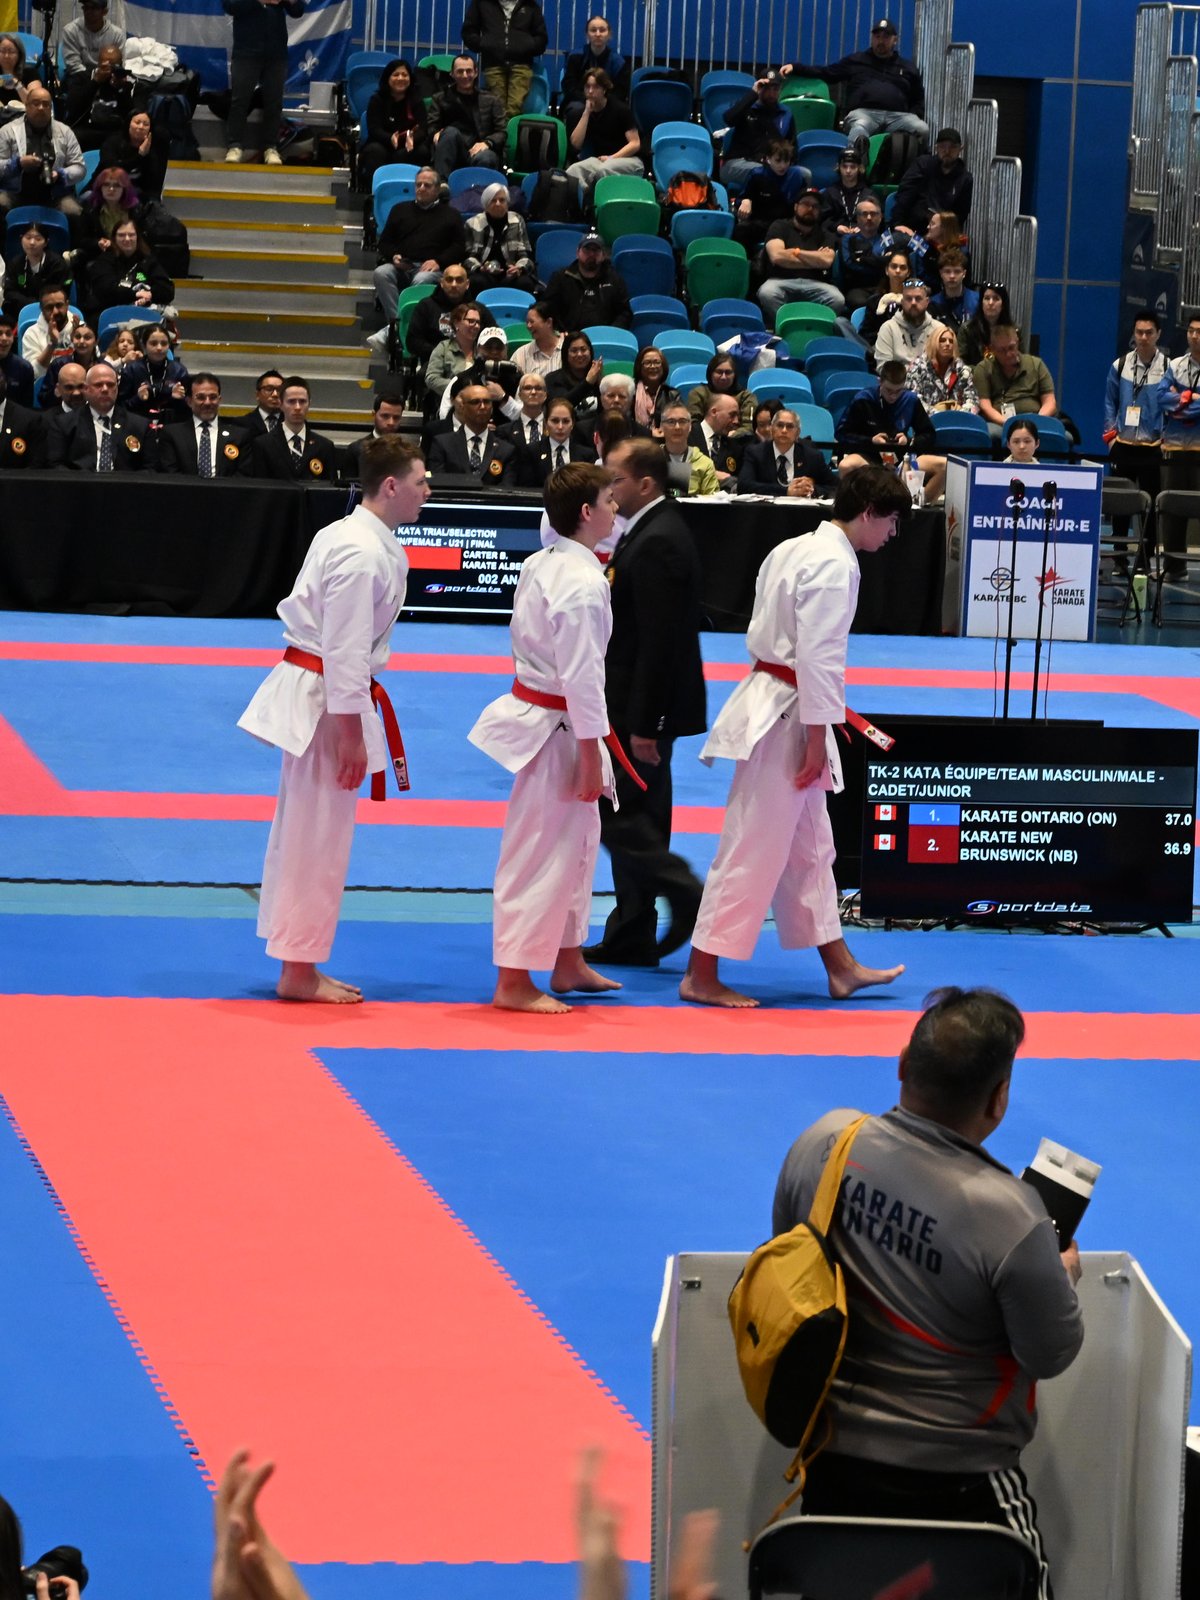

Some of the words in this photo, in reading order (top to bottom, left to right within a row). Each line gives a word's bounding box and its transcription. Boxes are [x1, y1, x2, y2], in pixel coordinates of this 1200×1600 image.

[397, 527, 421, 536] KATA
[422, 527, 497, 539] TRIAL/SELECTION
[448, 538, 464, 548] U21
[470, 539, 495, 549] FINAL
[462, 550, 498, 560] CARTER
[499, 551, 509, 560] B.
[462, 560, 497, 570] KARATE
[498, 562, 525, 571] ALBE
[478, 573, 499, 585] 002
[500, 574, 518, 585] AN
[1013, 595, 1027, 603] BC
[868, 765, 900, 779] TK-2
[903, 766, 941, 779] KATA
[944, 764, 1039, 781] ÉQUIPE/TEAM
[1042, 768, 1156, 783] MASCULIN/MALE
[868, 783, 972, 797] CADET/JUNIOR
[929, 809, 940, 822] 1.
[961, 810, 1018, 823] KARATE
[1021, 811, 1084, 825] ONTARIO
[1087, 811, 1117, 827] (ON)
[1165, 813, 1193, 826] 37.0
[927, 838, 940, 852] 2.
[960, 830, 1017, 844] KARATE
[1020, 831, 1053, 844] NEW
[1164, 842, 1191, 855] 36.9
[960, 848, 1046, 862] BRUNSWICK
[1048, 849, 1078, 865] (NB)
[842, 1205, 943, 1276] NTARIO
